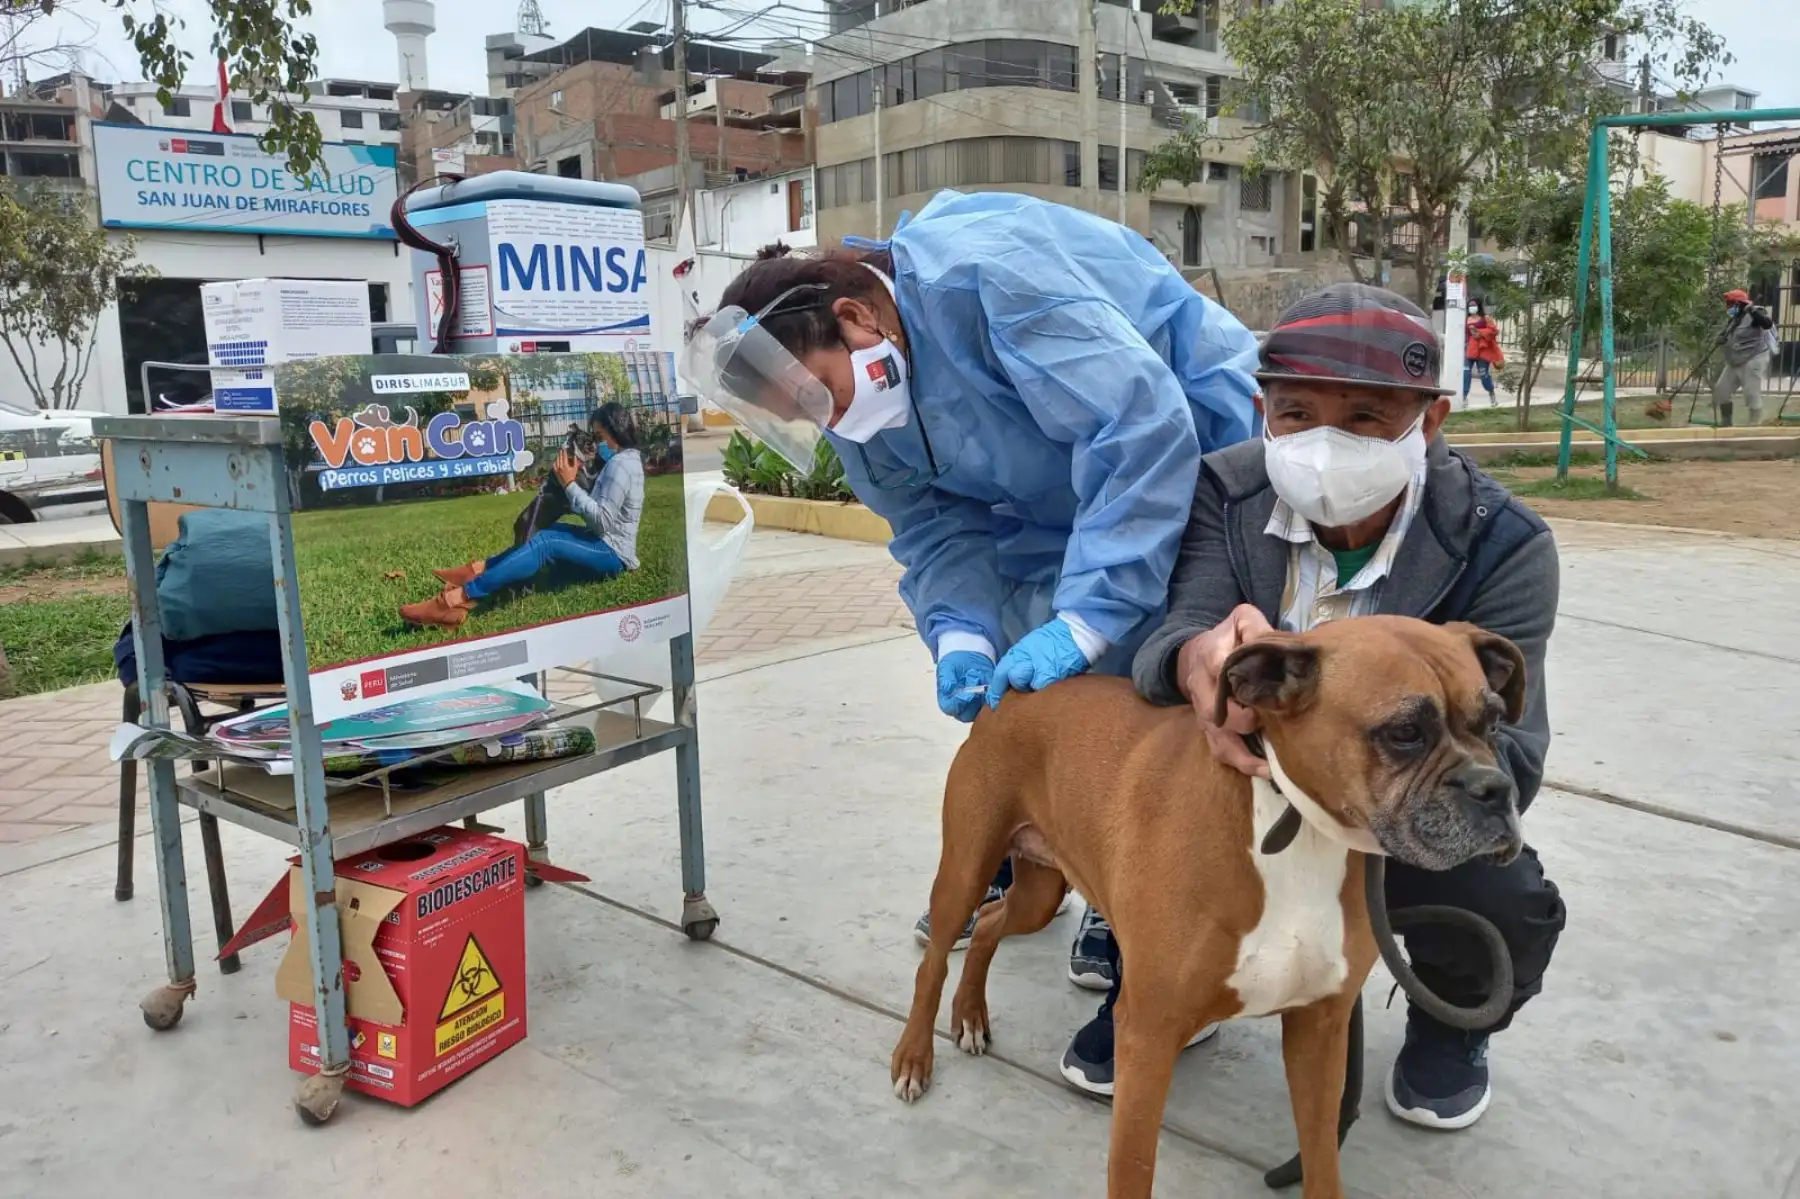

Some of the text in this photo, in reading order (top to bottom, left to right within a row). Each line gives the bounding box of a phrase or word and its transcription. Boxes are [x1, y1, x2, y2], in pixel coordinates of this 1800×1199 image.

[127, 159, 375, 196] CENTRO DE SALUD
[137, 190, 370, 217] SAN JUAN DE MIRAFLORES
[309, 412, 525, 468] Van Can
[383, 466, 435, 485] felices
[439, 464, 450, 478] y
[454, 459, 474, 475] sin
[417, 853, 517, 921] BIODESCARTE
[438, 1030, 465, 1053] RIESGO
